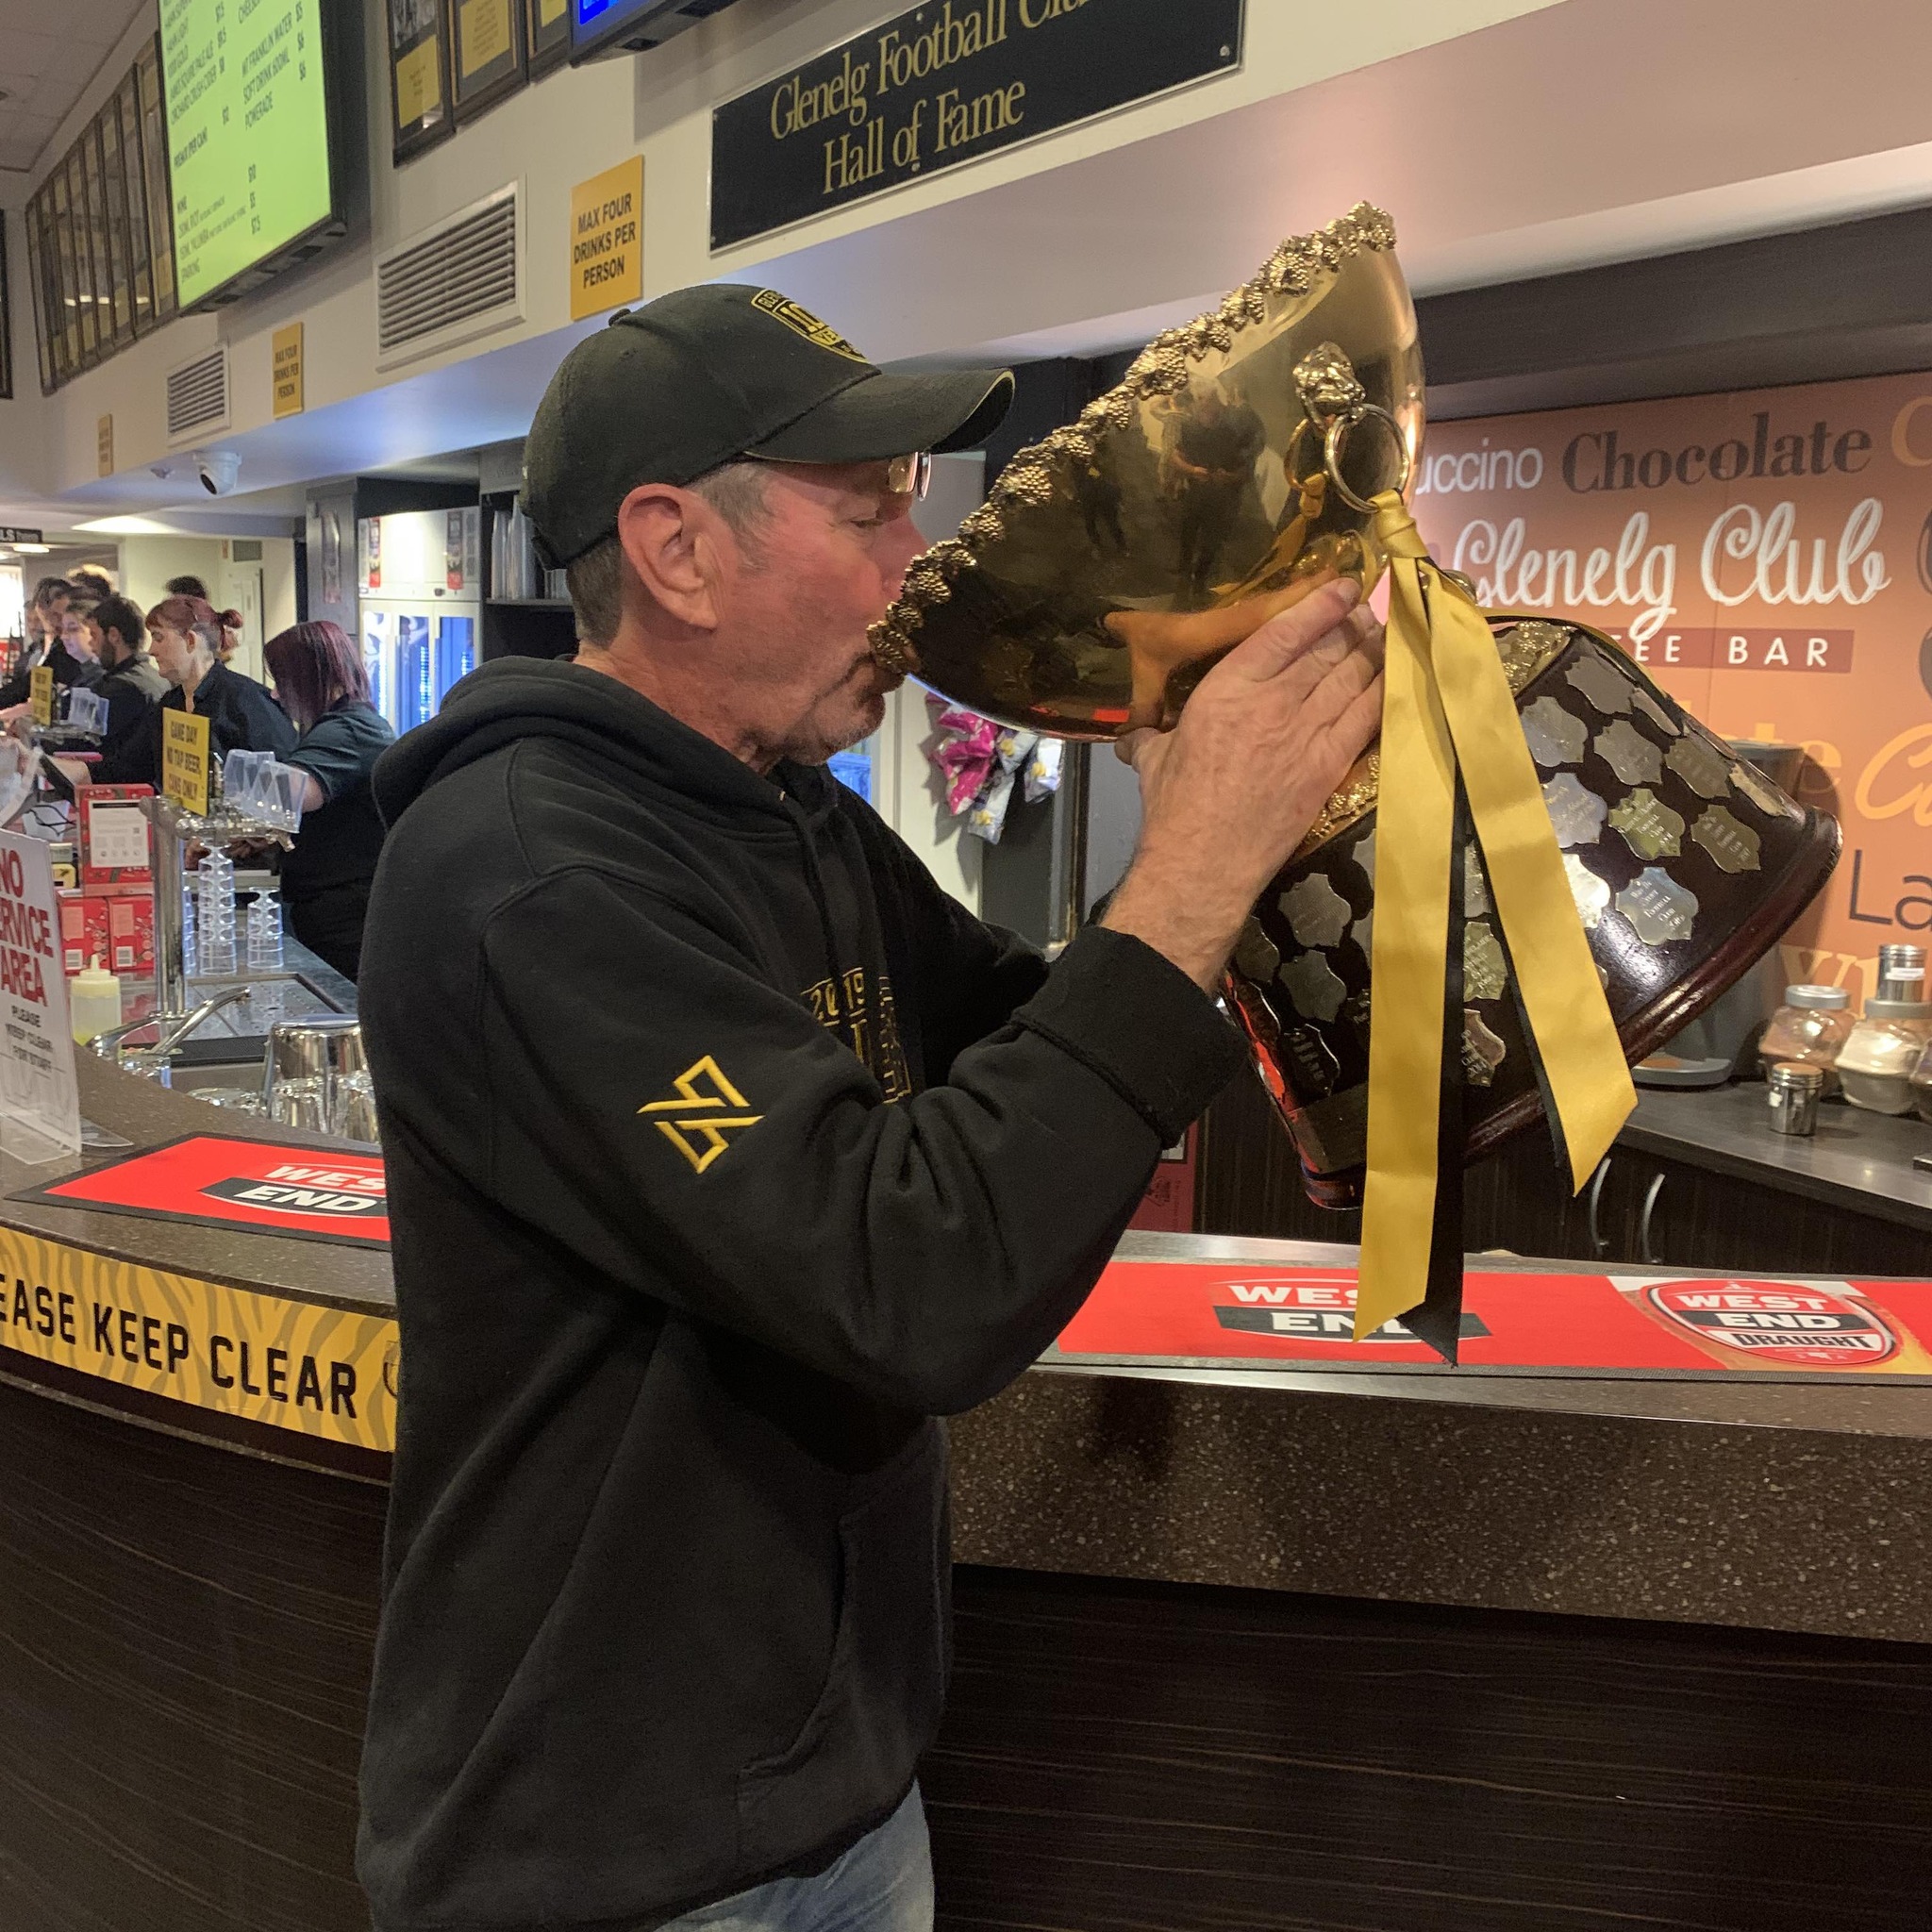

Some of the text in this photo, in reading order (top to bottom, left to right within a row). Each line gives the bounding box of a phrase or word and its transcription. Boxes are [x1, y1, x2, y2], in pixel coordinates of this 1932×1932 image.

[770, 0, 1008, 140] Glenelg Football
[824, 80, 1025, 194] Hall of Fame
[577, 192, 632, 235] MAX FOUR
[574, 222, 636, 265] DRINKS PER
[583, 255, 625, 289] PERSON
[1562, 412, 1872, 495] Chocolate
[1454, 497, 1892, 642] Glenelg Club
[1610, 634, 1829, 667] EE BAR
[0, 946, 47, 1008] AREA
[234, 1185, 377, 1211] END
[1228, 1285, 1357, 1306] WE
[1676, 1294, 1828, 1310] WEST
[1714, 1313, 1841, 1329] END
[1730, 1333, 1873, 1349] DRAUGHT
[93, 1302, 189, 1374] KEEP
[209, 1335, 358, 1419] CLEAR
